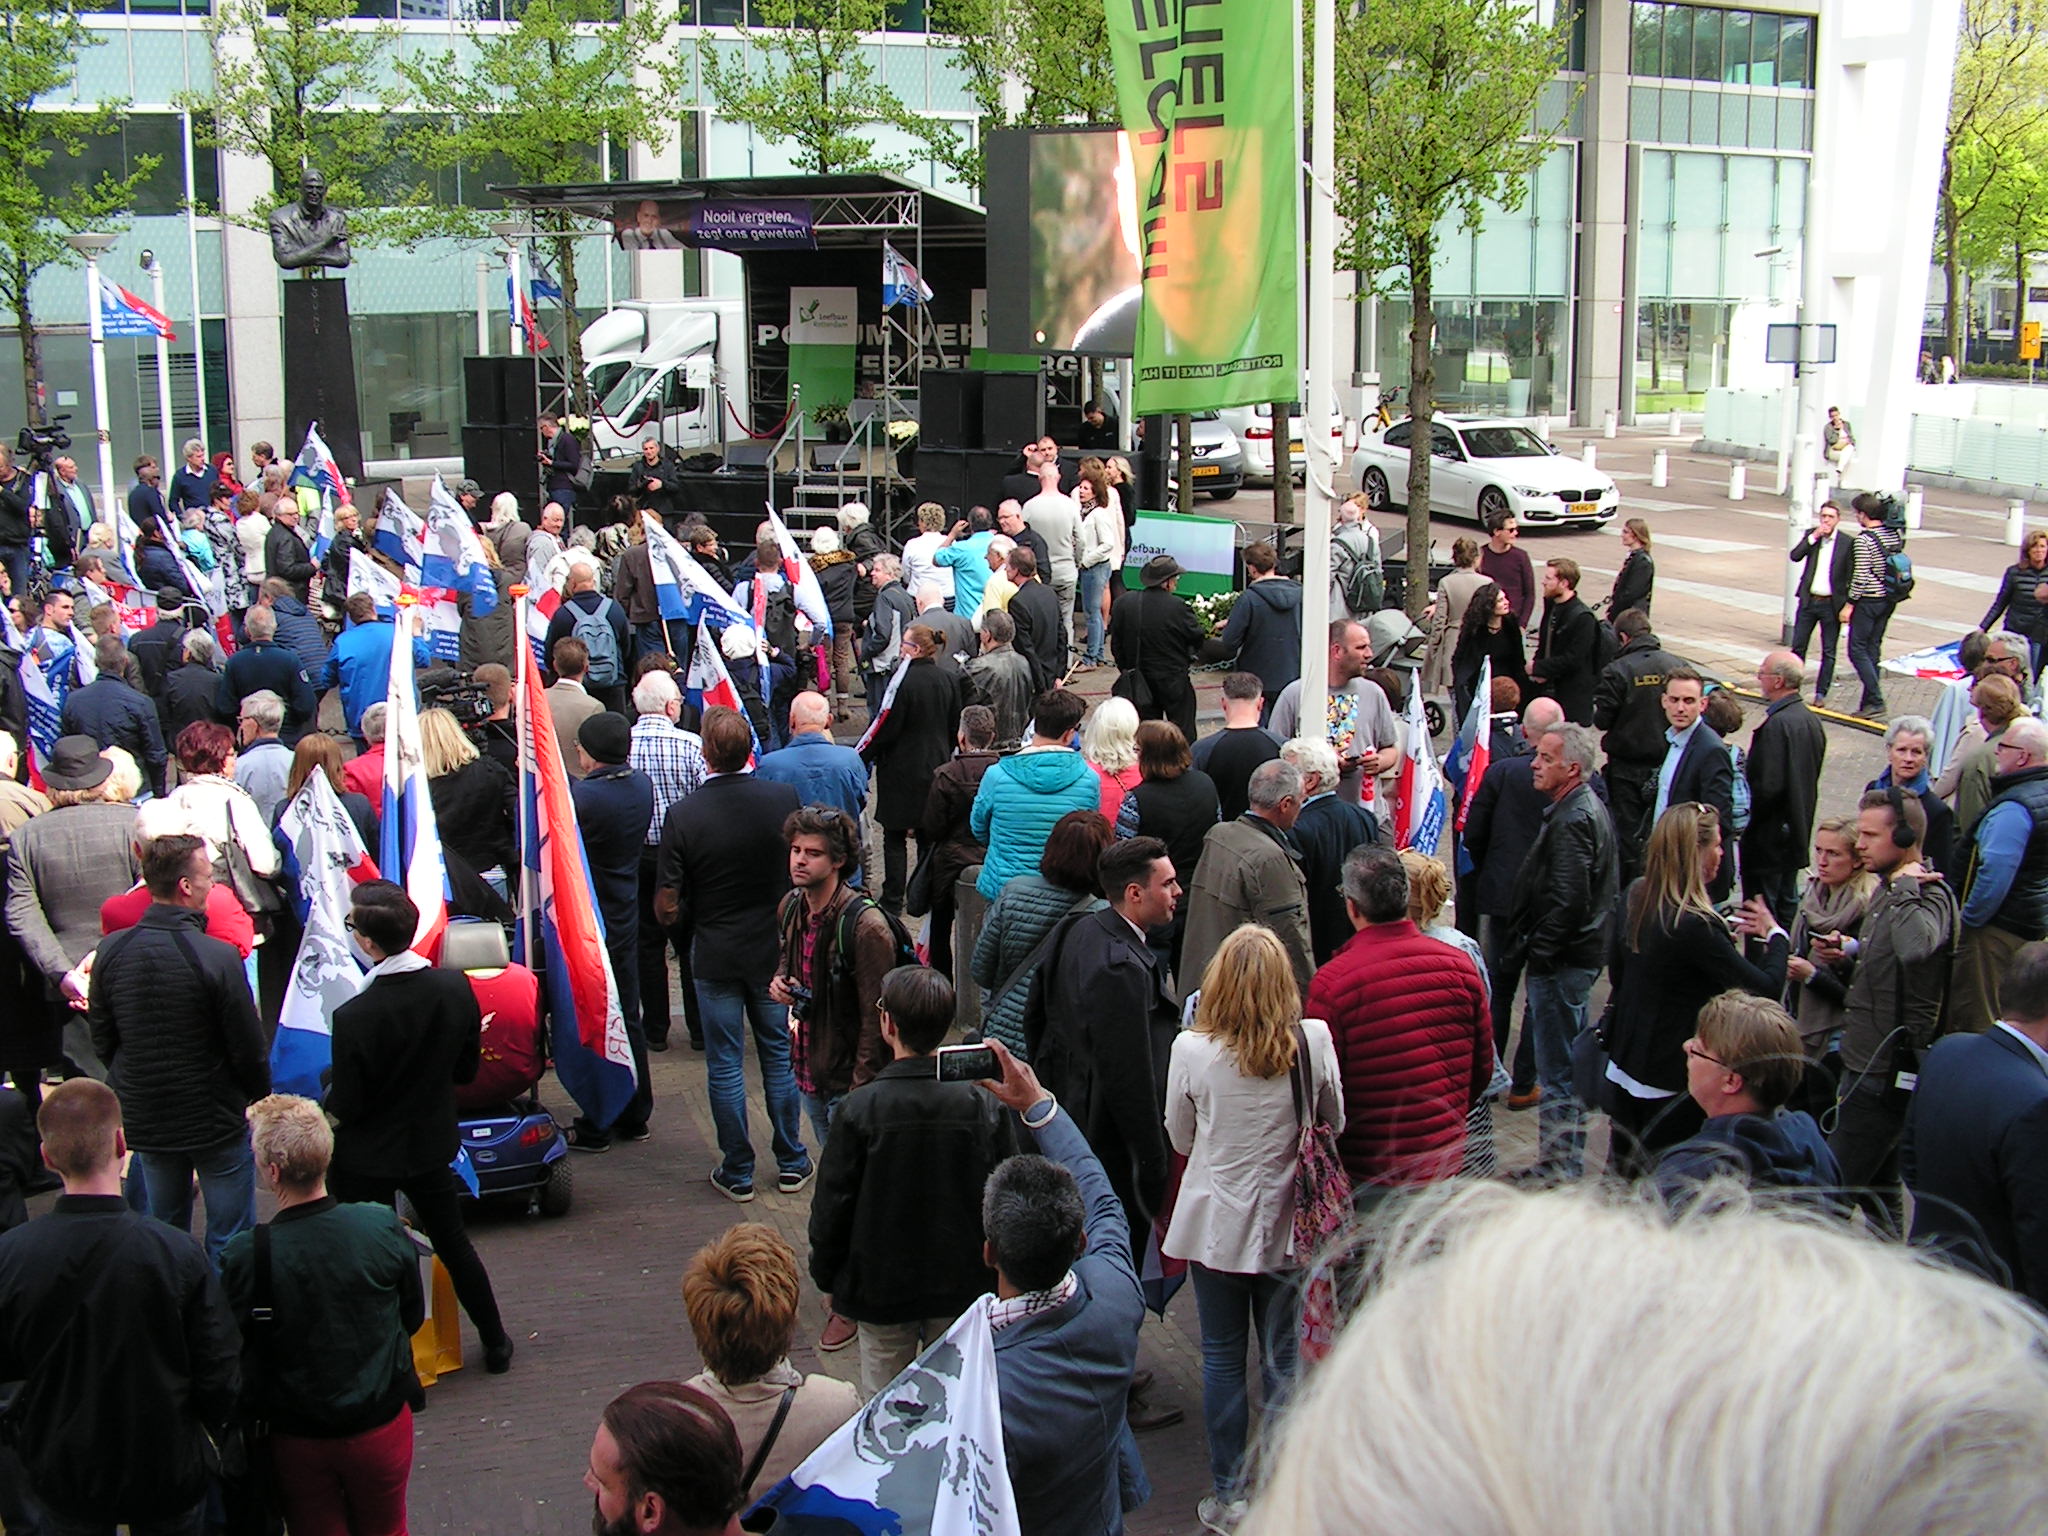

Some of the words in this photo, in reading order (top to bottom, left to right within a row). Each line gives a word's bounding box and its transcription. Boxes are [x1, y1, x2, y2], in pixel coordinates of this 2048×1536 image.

[703, 210, 736, 224] Nooit
[696, 228, 724, 242] zegt
[726, 229, 749, 240] ons
[751, 228, 807, 242] geweten!
[1131, 543, 1166, 554] efbaar
[1634, 674, 1661, 687] LED
